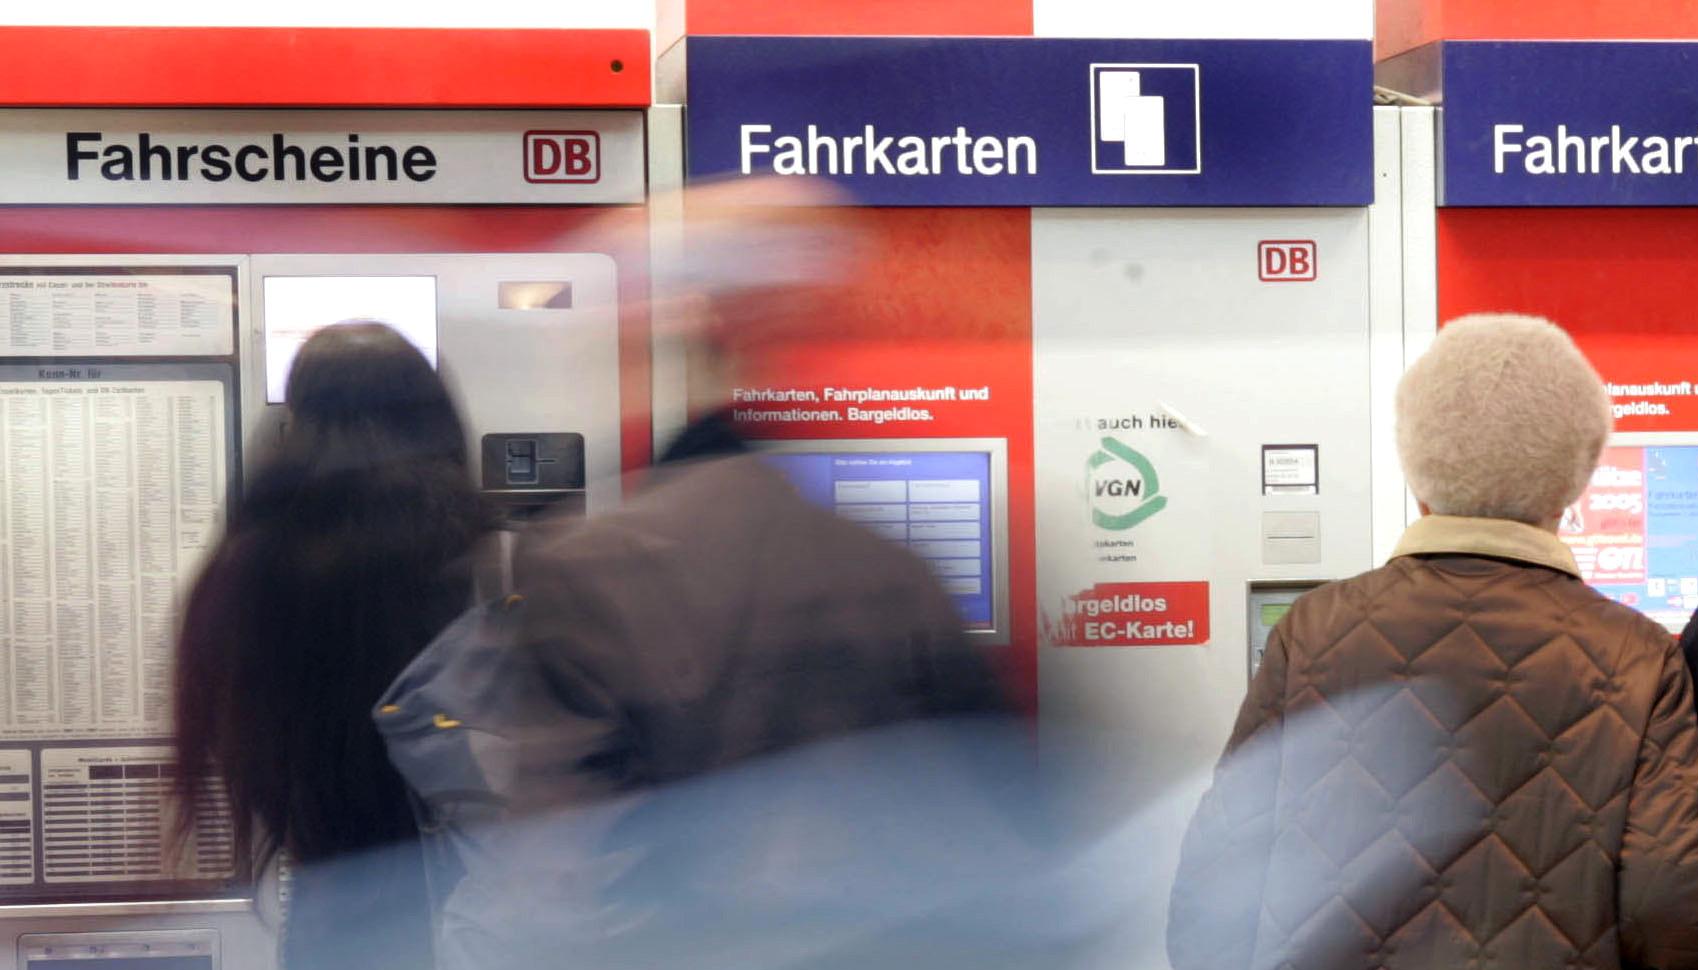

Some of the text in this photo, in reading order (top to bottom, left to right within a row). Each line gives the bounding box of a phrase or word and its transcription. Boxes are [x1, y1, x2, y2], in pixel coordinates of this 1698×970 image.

[66, 131, 437, 182] Fahrscheine
[532, 138, 592, 176] DB
[741, 125, 1036, 178] Fahrkarten
[1265, 247, 1311, 275] DB
[733, 387, 989, 403] Fahrkarten, Fahrplanauskunft und
[733, 407, 933, 423] Informationen. Bargeldlos.
[1099, 416, 1142, 429] auch
[1151, 415, 1180, 428] hie
[1096, 480, 1140, 496] VGN
[1084, 619, 1195, 641] EC-Karte!
